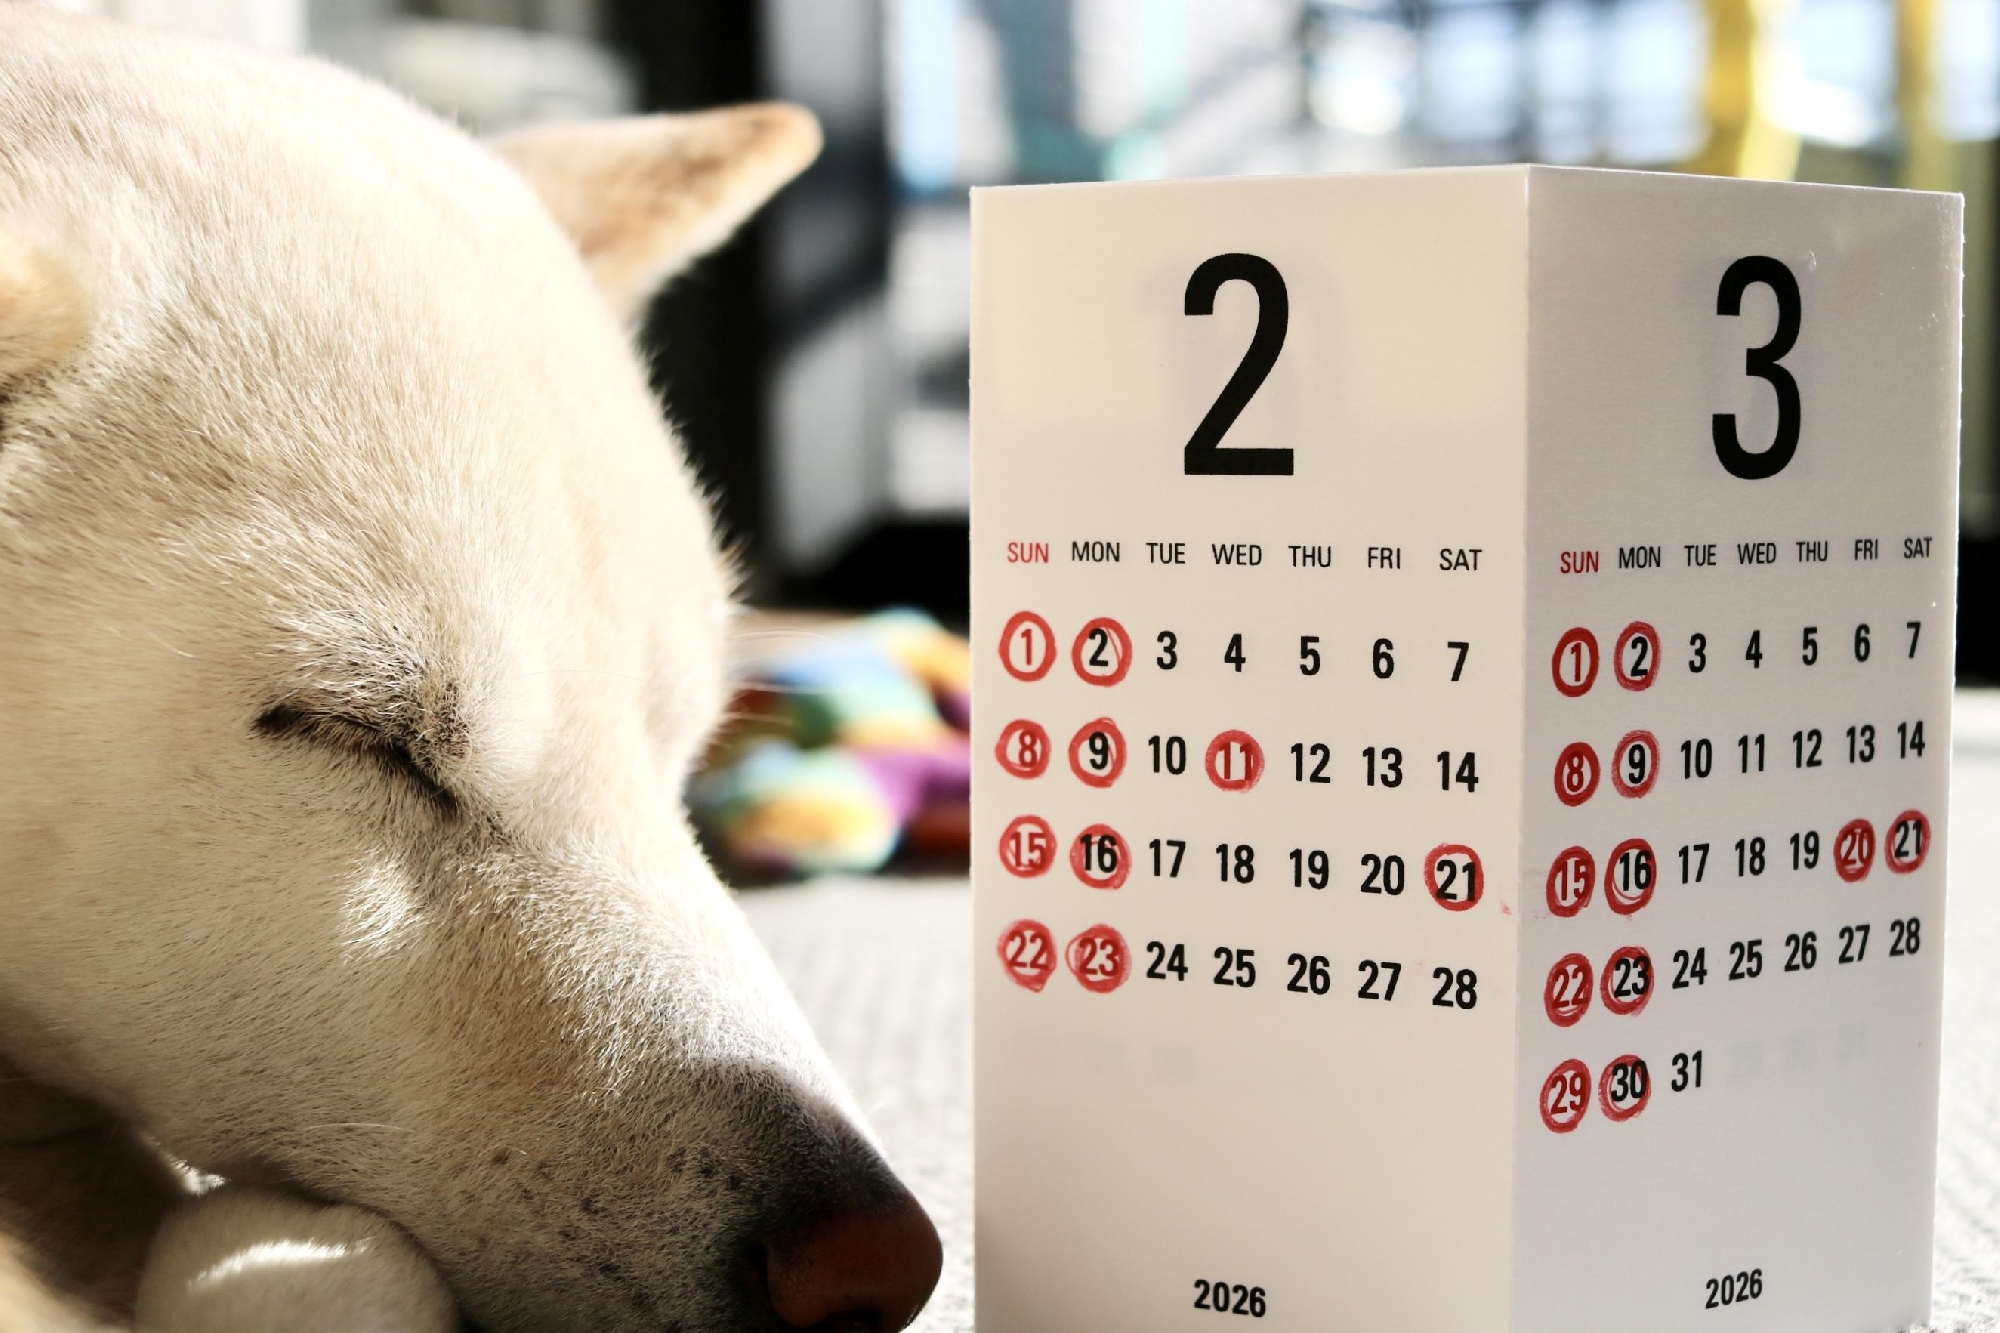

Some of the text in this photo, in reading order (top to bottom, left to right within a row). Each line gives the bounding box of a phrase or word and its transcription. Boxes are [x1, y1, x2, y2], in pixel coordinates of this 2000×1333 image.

[1184, 252, 1294, 476] 2
[1711, 255, 1803, 481] 3
[1007, 541, 1482, 571] SUN MON TUE WED THU FRI SAT
[1559, 536, 1933, 576] SUN MON TUE WED THU FRI SAT
[1021, 629, 1470, 682] 1 2 3 4 5 6 7
[1570, 621, 1922, 682] 1 2 3 4 5 6 7
[1019, 730, 1479, 793] 8 9 10 11 12 13 14
[1566, 720, 1926, 792] 8 9 10 11 12 13 14
[1010, 832, 1476, 900] 15 16 17 18 19 20 21
[1556, 820, 1922, 901] 15 16 17 18 19 20 21
[1009, 934, 1478, 1010] 22 23 24 25 26 27 28
[1553, 917, 1921, 1008] 22 23 24 25 26 27 28
[1551, 1073, 1584, 1114] 29
[1611, 1061, 1648, 1102] 30
[1671, 1050, 1703, 1093] 31
[1193, 1279, 1266, 1318] 2026
[1705, 1268, 1763, 1310] 2026
